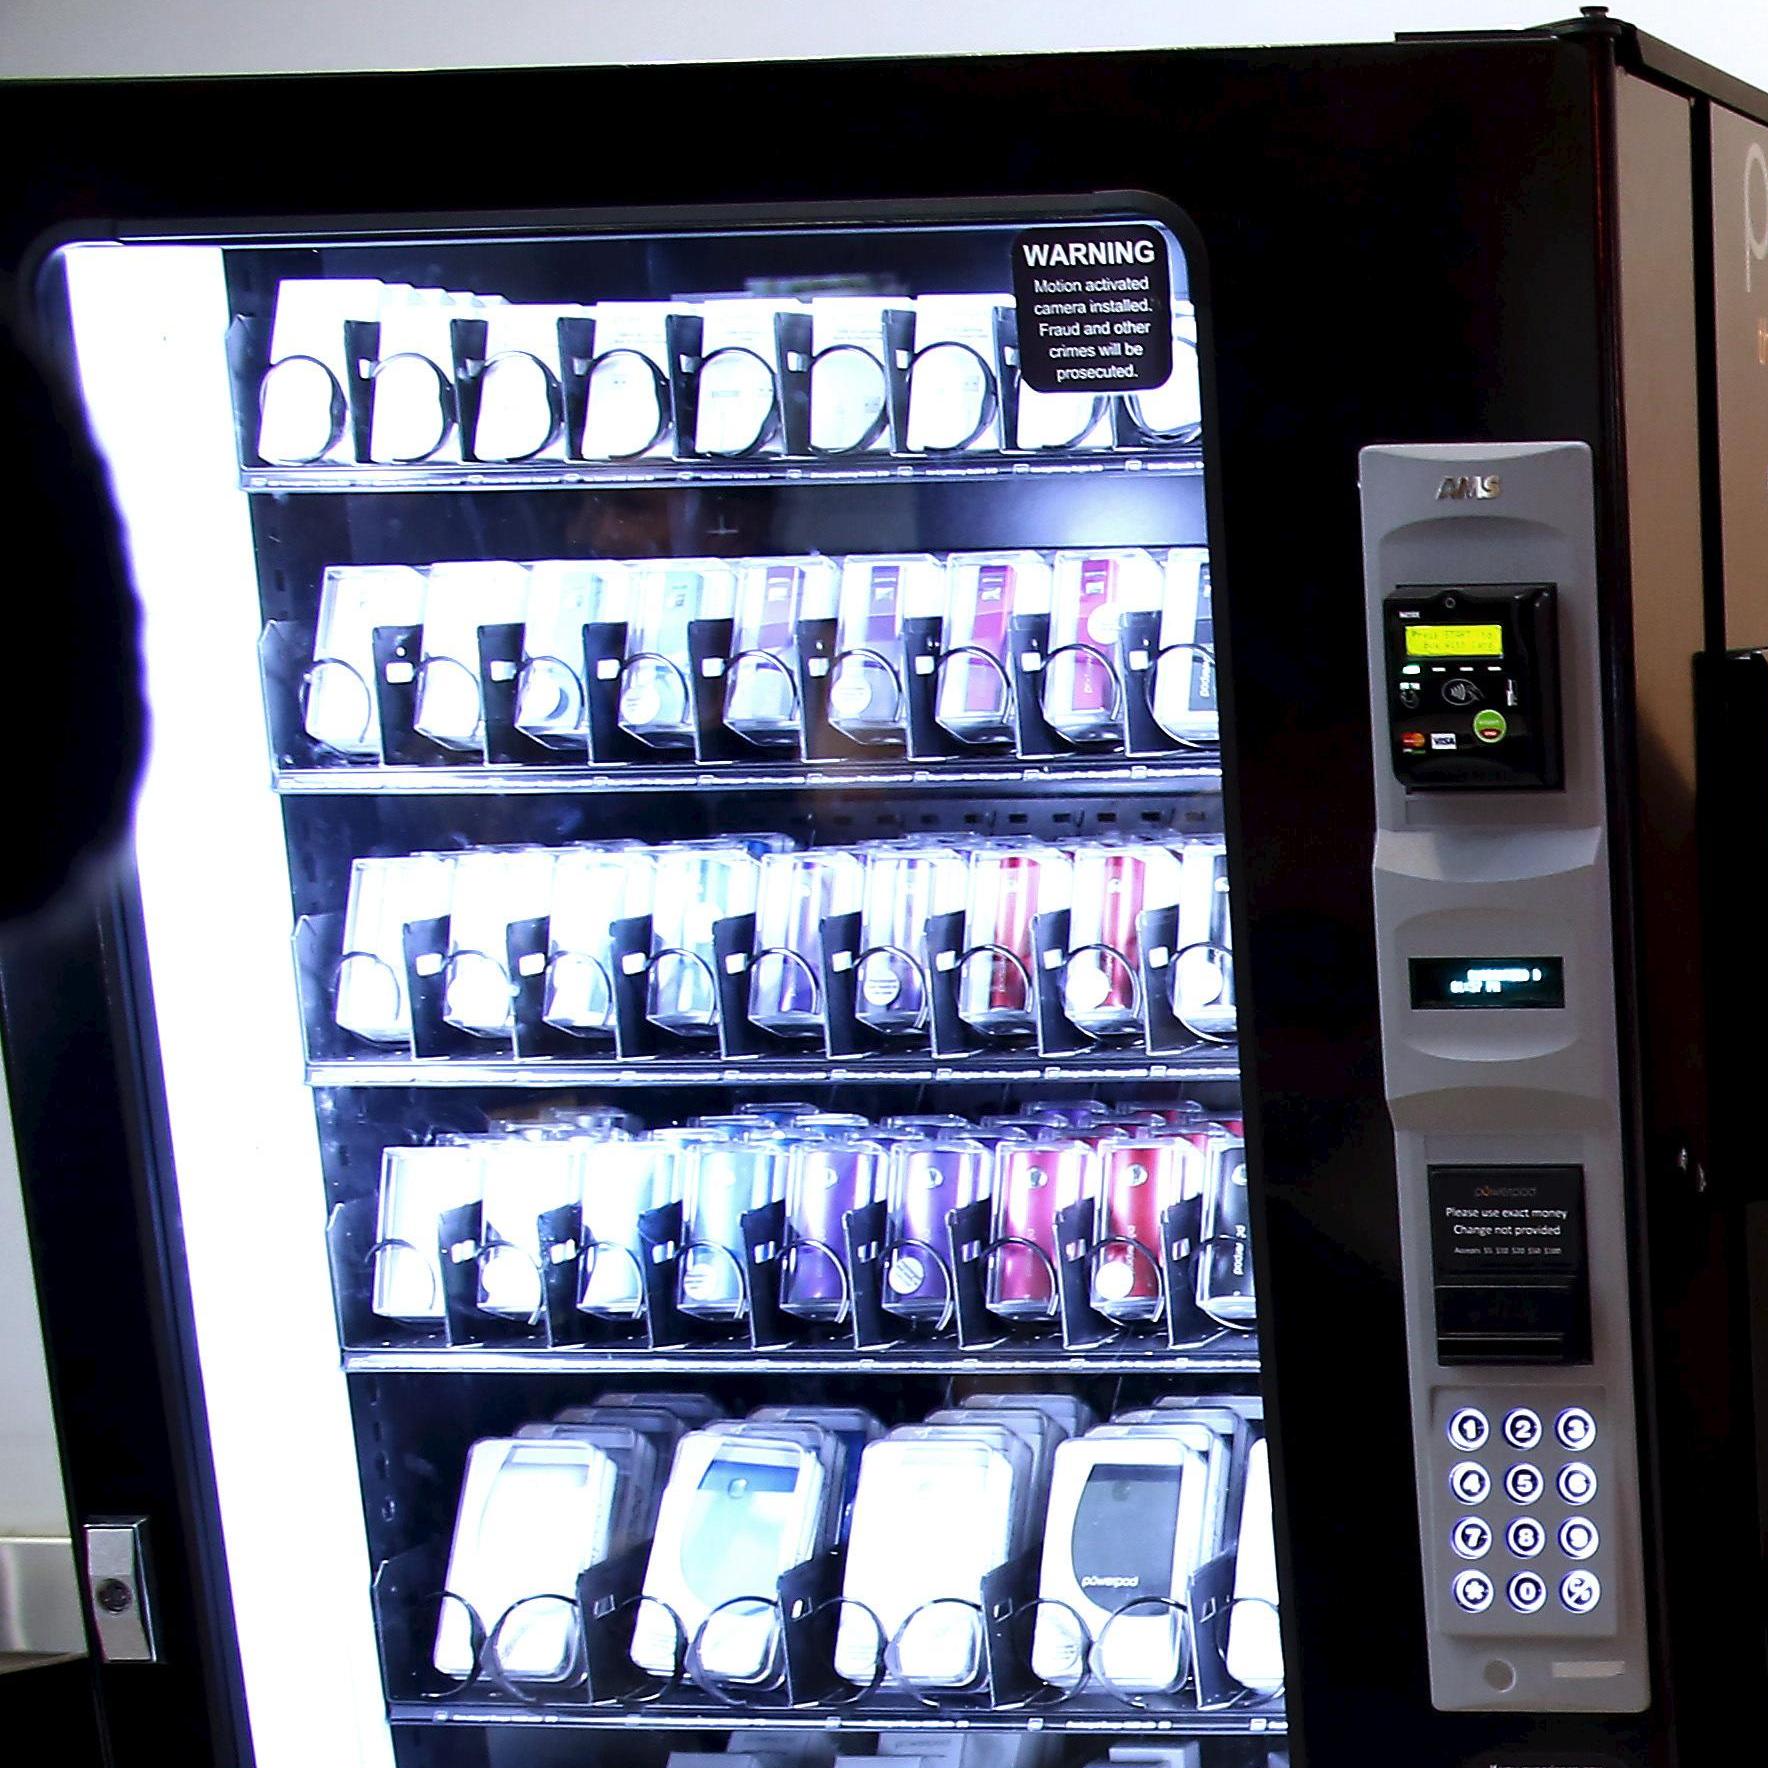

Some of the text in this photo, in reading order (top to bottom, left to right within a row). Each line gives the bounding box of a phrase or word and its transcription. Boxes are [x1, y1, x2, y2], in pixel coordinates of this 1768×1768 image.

[1023, 240, 1155, 267] WARNING
[1034, 276, 1149, 293] Motion activated
[1034, 299, 1152, 315] camera installed.
[1039, 321, 1151, 337] Fraud and other
[1049, 343, 1143, 358] crimes will be
[1056, 364, 1138, 382] prosecuted.
[1436, 475, 1500, 500] AMS
[1446, 1207, 1568, 1220] Please use exact money
[1454, 1224, 1561, 1237] Change not provided
[1462, 1418, 1585, 1439] 1 2 3
[1463, 1473, 1481, 1493] 4
[1516, 1474, 1533, 1492] 5
[1464, 1528, 1481, 1547] 7
[1517, 1528, 1534, 1546] 8
[1520, 1582, 1534, 1600] 0
